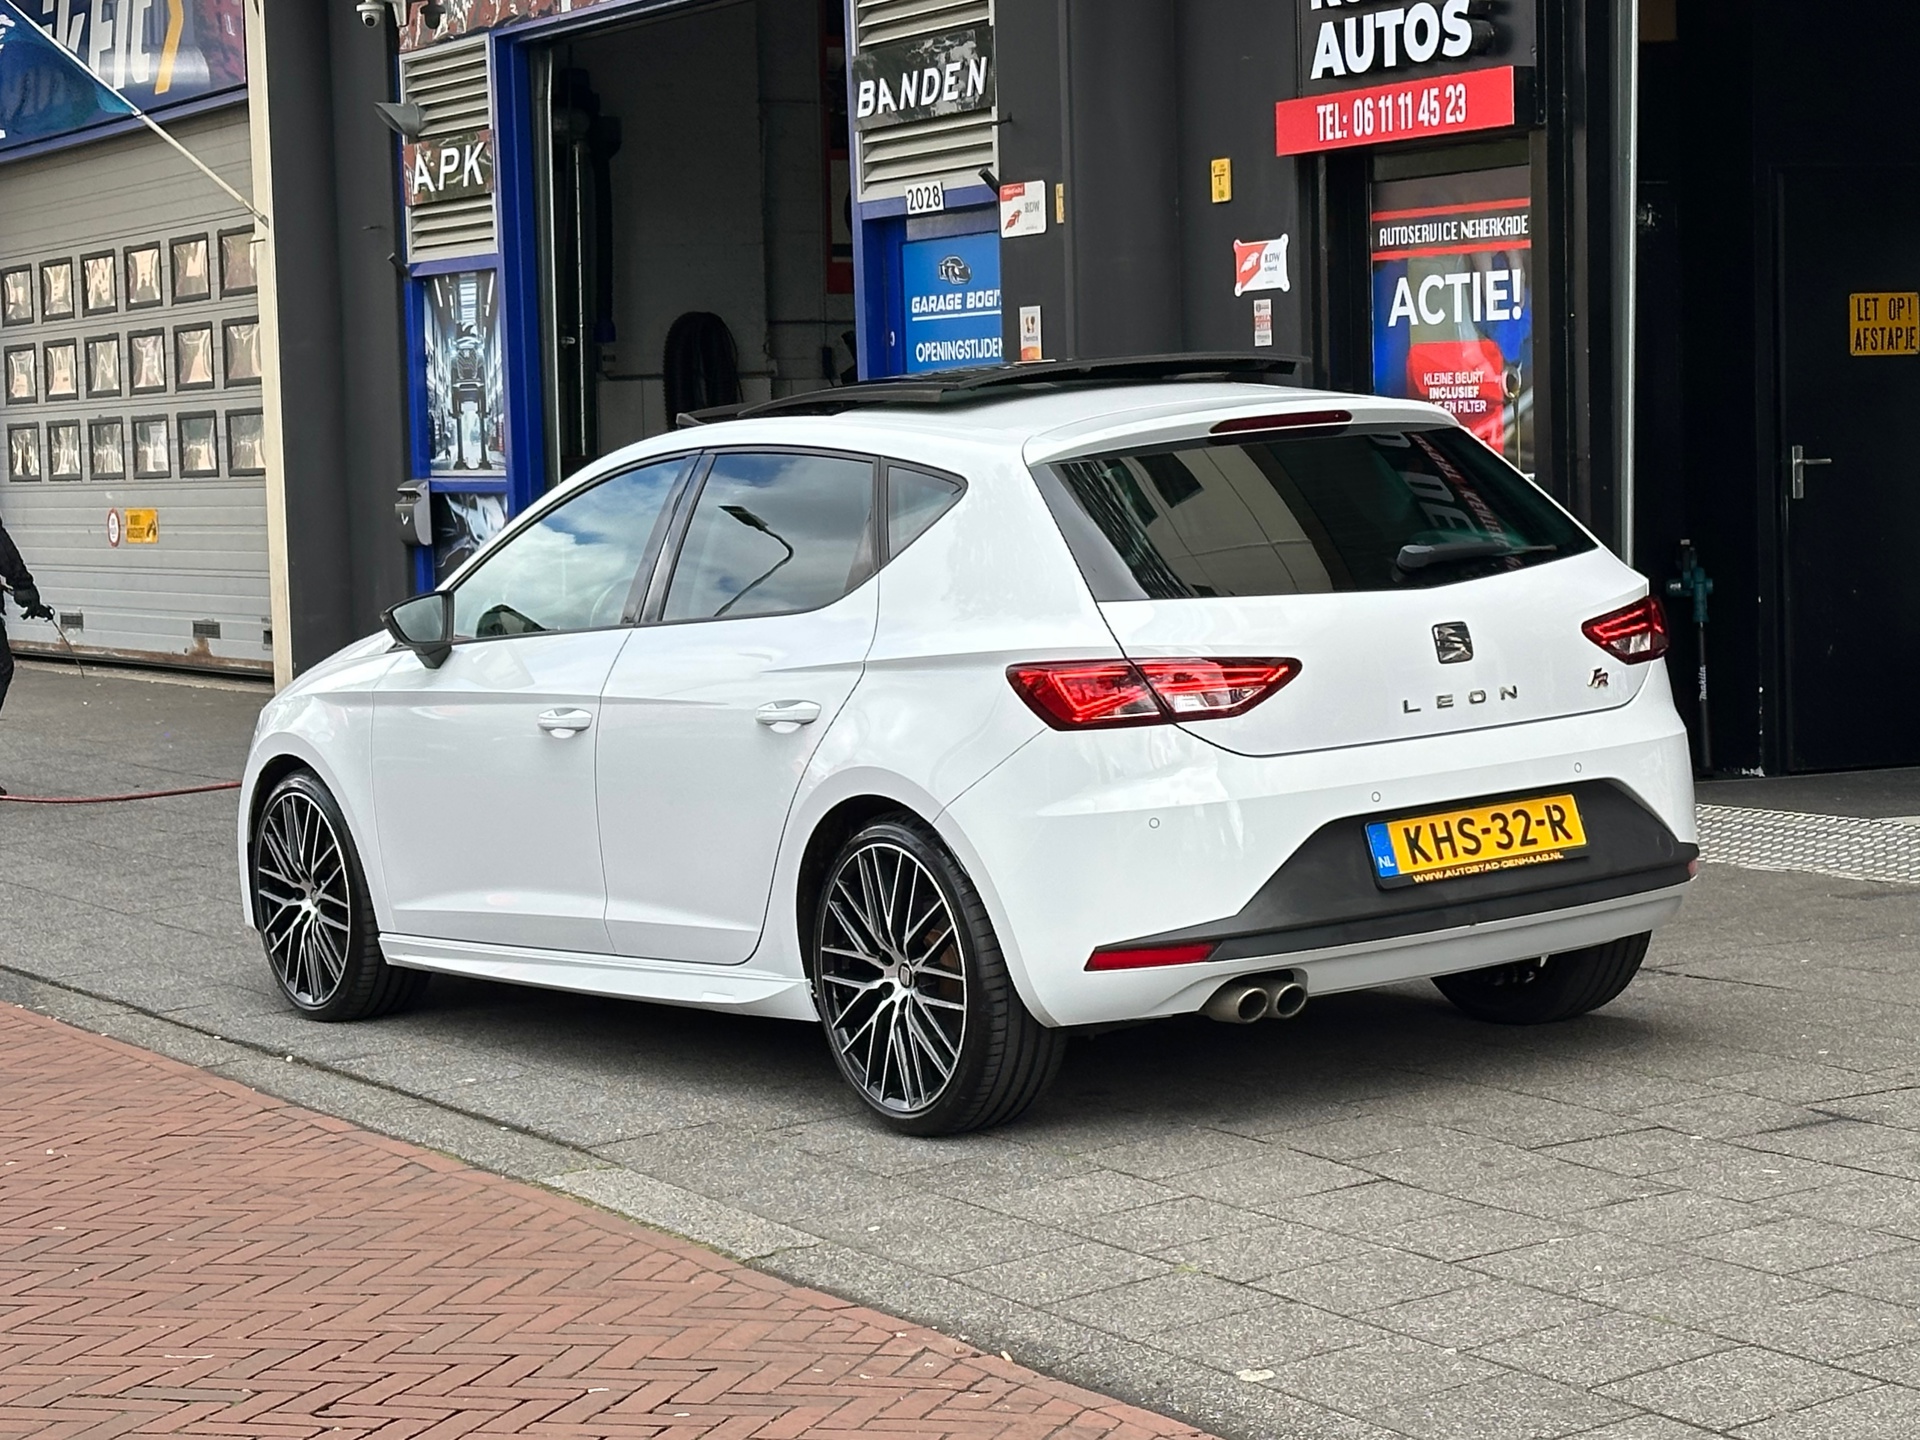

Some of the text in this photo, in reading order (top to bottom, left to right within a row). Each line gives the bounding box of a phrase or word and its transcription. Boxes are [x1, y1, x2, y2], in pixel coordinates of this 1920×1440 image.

[1310, 0, 1473, 80] AUTOS
[856, 56, 988, 119] BANDEN
[1316, 82, 1468, 142] TEL: 06 11 11 45 23
[412, 141, 485, 195] APK
[907, 185, 942, 211] 2028
[1379, 214, 1530, 247] AUTOSERVICE NEHERKADE
[911, 292, 963, 314] GARAGE
[1387, 268, 1523, 327] ACTIE!
[1856, 297, 1879, 321] LET
[1854, 326, 1917, 351] AFSTAPJE
[1423, 370, 1485, 386] KLEINE BEURT
[1429, 385, 1479, 400] INCLUSIEF
[1457, 400, 1487, 413] FILTER
[1402, 685, 1519, 714] LEON
[1402, 803, 1574, 866] KHS-32-R
[1377, 855, 1395, 868] NL
